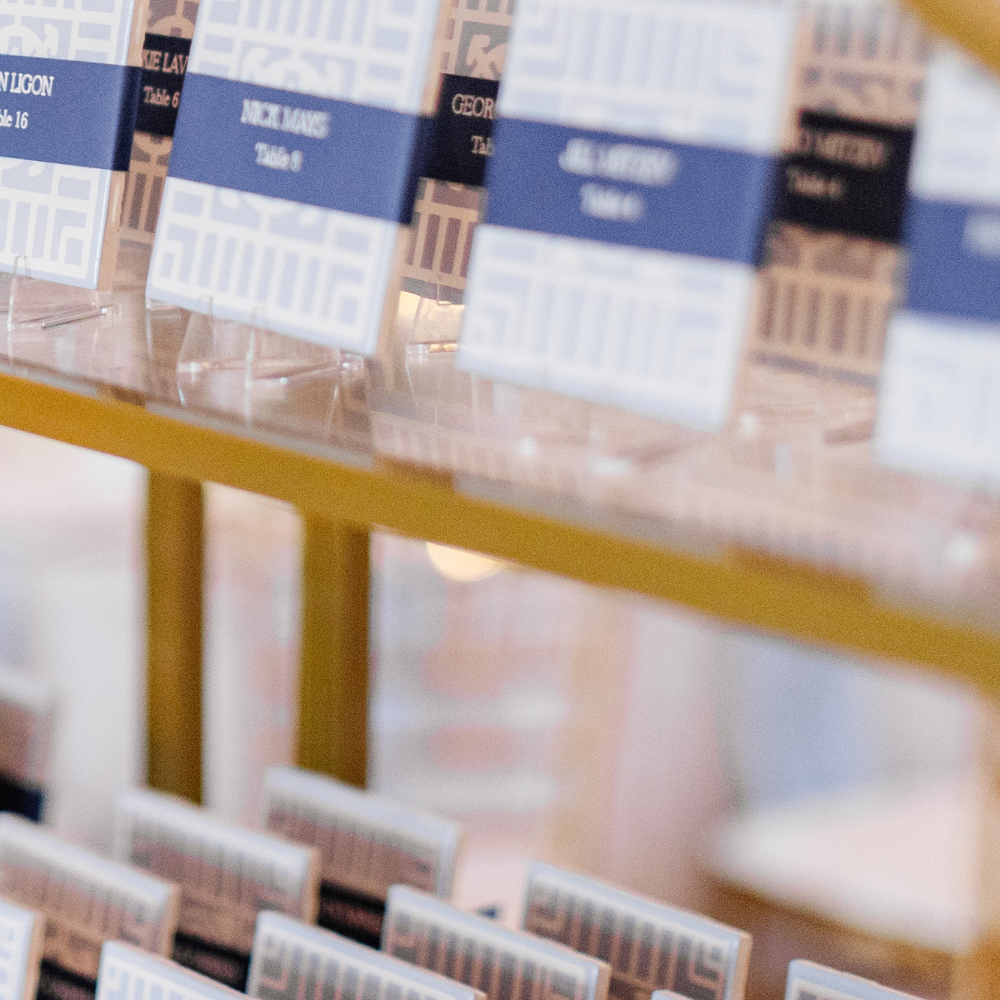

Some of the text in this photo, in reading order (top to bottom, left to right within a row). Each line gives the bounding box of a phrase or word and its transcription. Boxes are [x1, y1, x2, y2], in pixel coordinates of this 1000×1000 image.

[8, 72, 54, 97] LIGON
[143, 85, 181, 108] Table 6
[15, 111, 29, 129] 16
[240, 98, 281, 130] NICK
